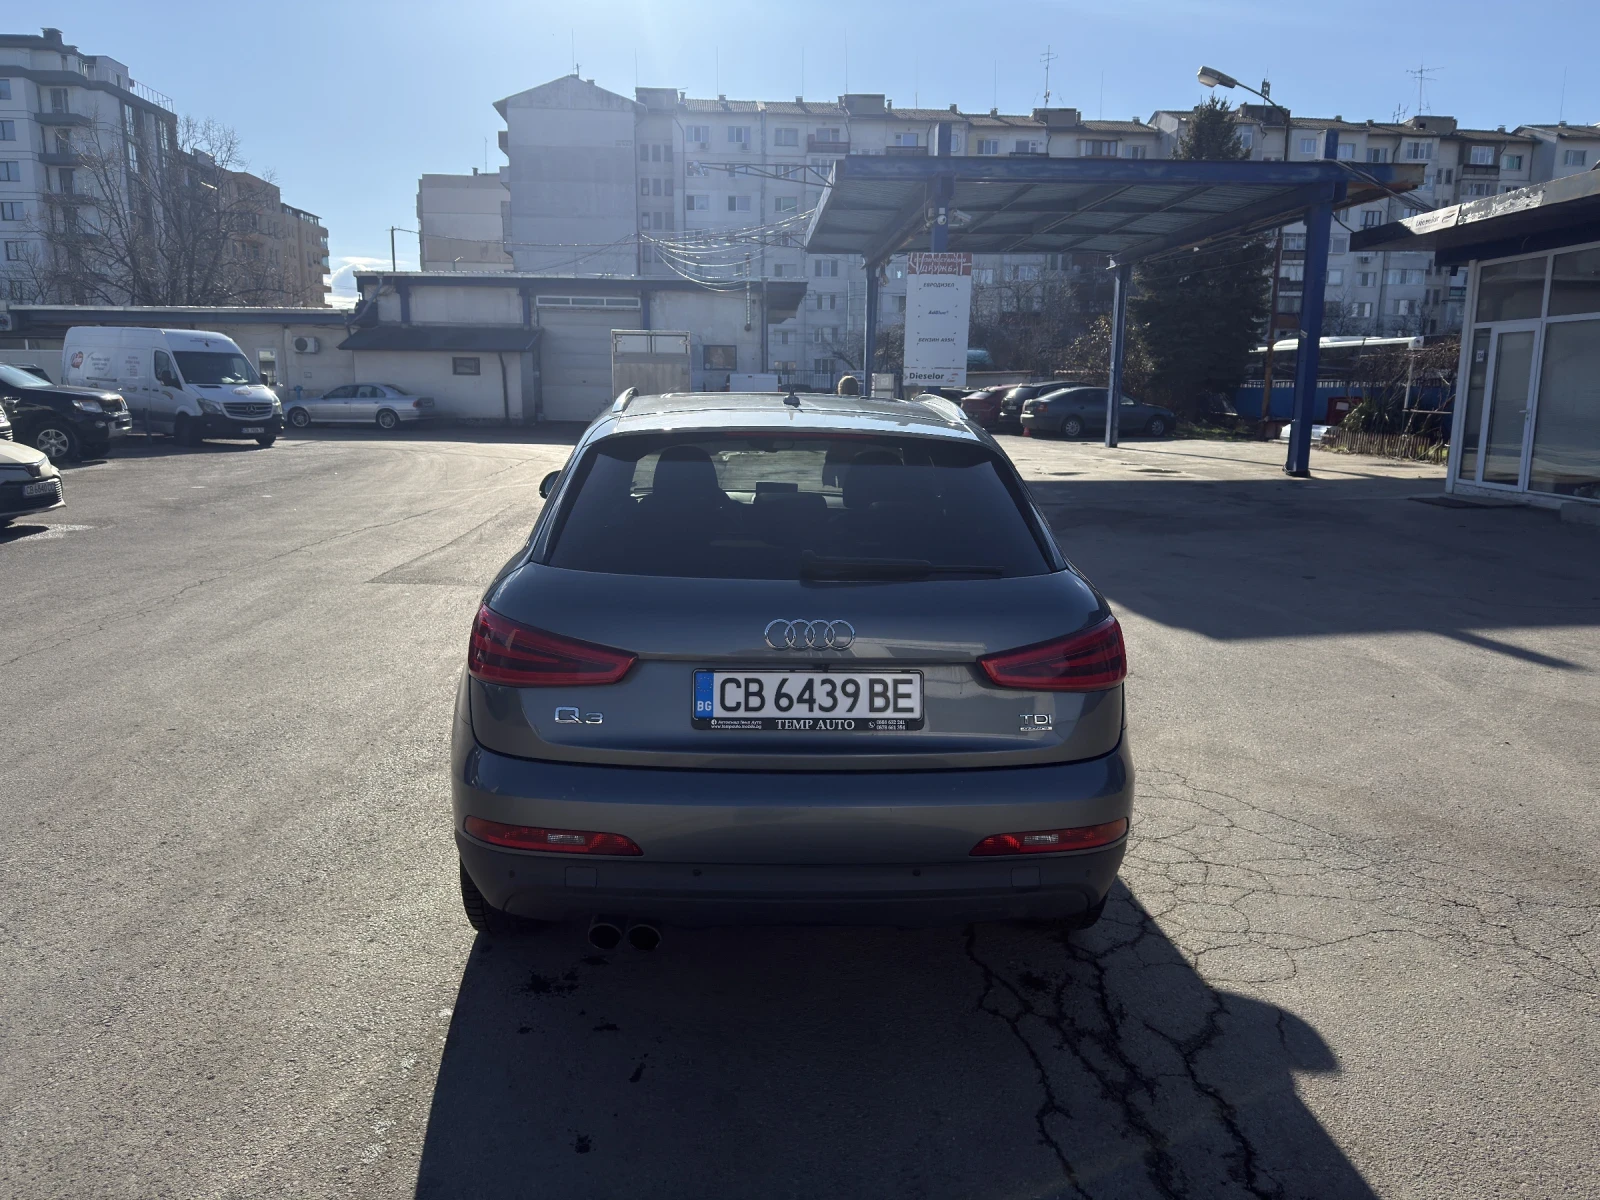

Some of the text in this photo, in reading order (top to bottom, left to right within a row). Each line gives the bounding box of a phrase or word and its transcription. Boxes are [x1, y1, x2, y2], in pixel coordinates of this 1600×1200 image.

[909, 372, 945, 380] Dieselor
[719, 677, 915, 713] CB 6439 BE
[696, 701, 712, 711] BG
[554, 706, 604, 724] Q3
[1019, 714, 1052, 725] TDI
[775, 719, 855, 730] TEMP AUTO
